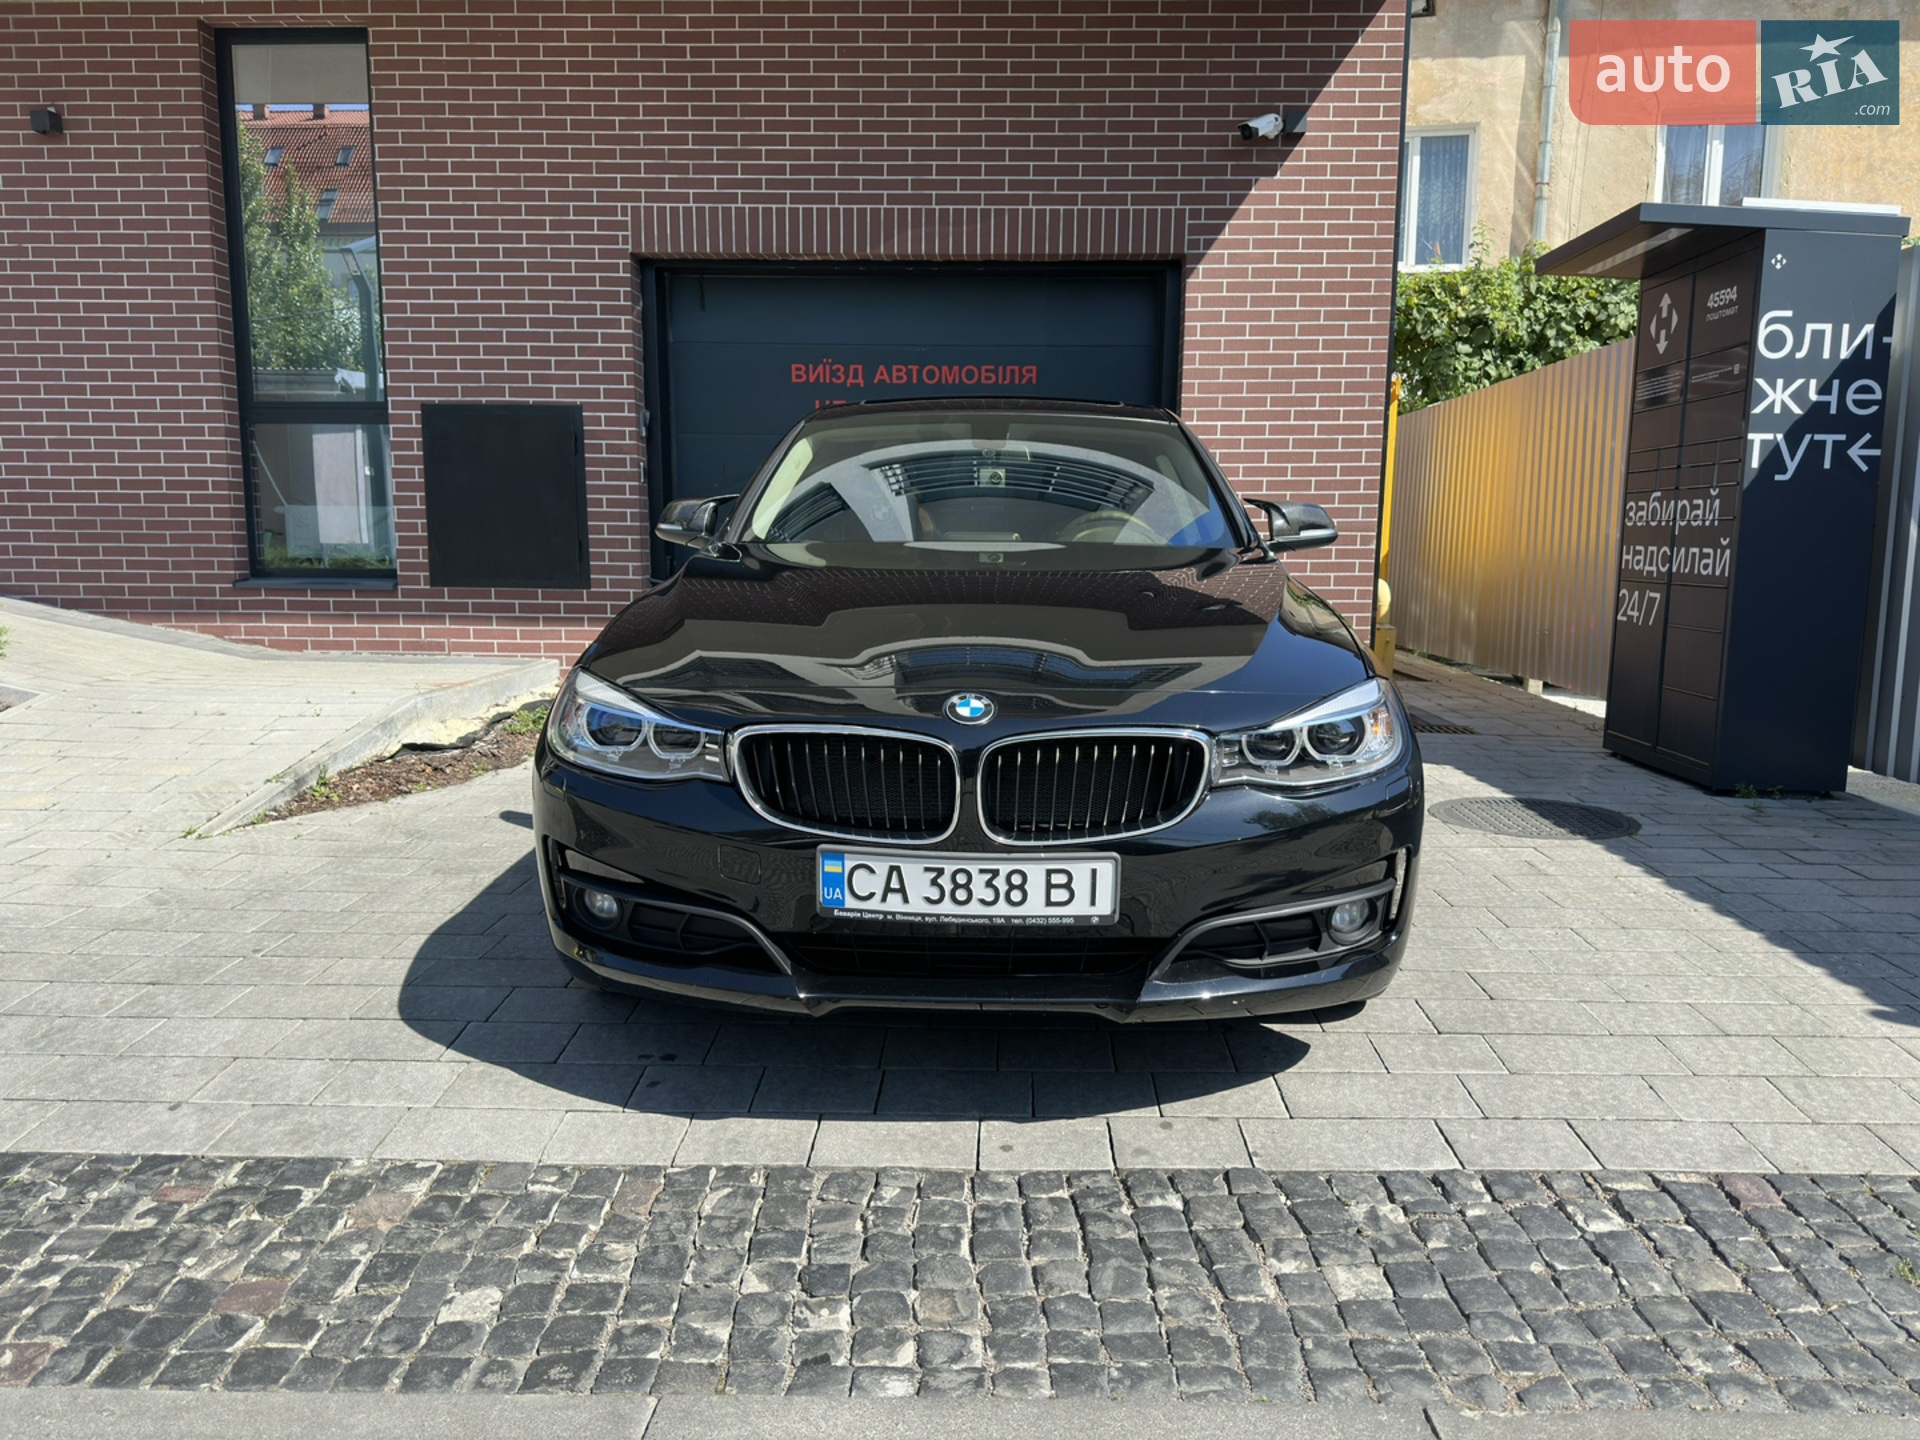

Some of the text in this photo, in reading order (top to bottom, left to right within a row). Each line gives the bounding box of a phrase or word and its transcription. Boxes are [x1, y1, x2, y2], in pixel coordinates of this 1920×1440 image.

[1706, 305, 1738, 321] поштомат
[1707, 286, 1737, 309] 45594
[1757, 310, 1893, 360] бли-
[791, 358, 1038, 387] ВИЇЗД АВТОМОБІЛЯ
[1751, 378, 1883, 416] жче
[1747, 433, 1846, 480] тут
[1625, 488, 1720, 535] забирай
[1621, 537, 1731, 577] надсилай
[1617, 588, 1660, 626] 24/7
[823, 888, 843, 900] UA
[922, 866, 1029, 907] 3838
